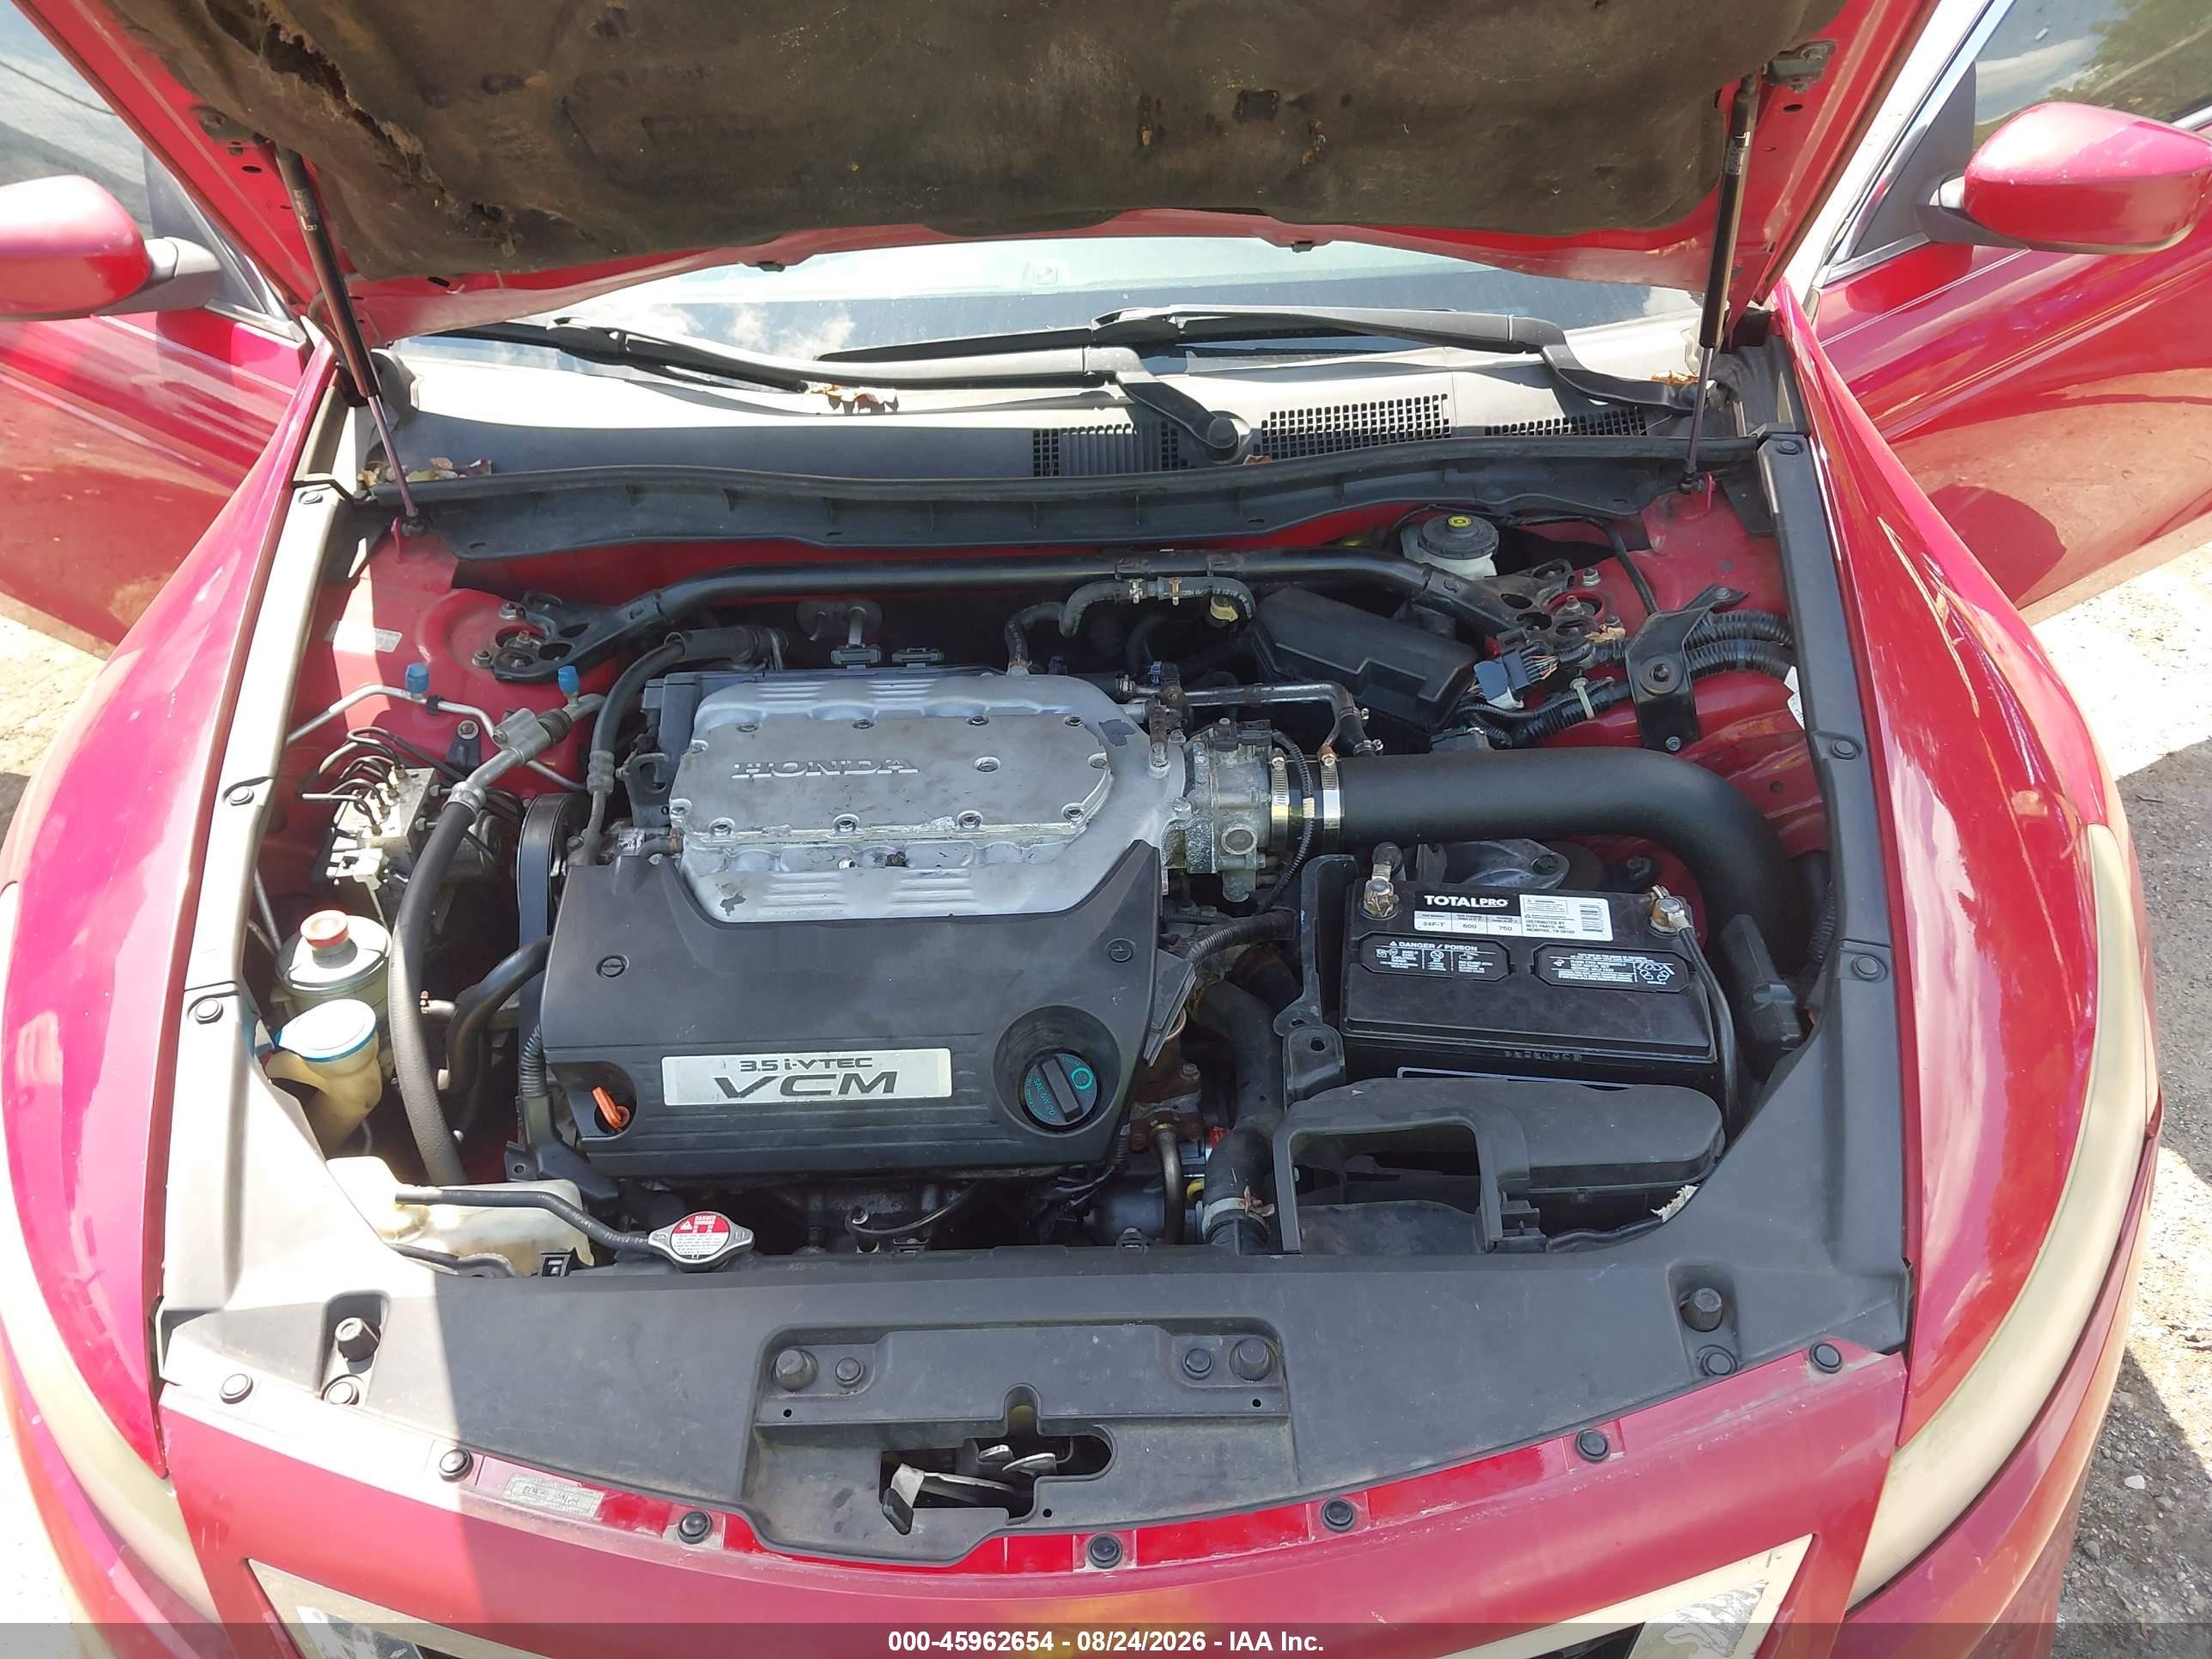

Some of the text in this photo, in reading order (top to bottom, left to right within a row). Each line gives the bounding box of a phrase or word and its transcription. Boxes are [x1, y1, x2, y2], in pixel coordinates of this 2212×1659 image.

[731, 759, 920, 779] HONDA
[1424, 895, 1509, 908] TOTALPRO
[740, 1057, 873, 1072] 3.5 i-VTEC
[714, 1071, 898, 1099] VCM
